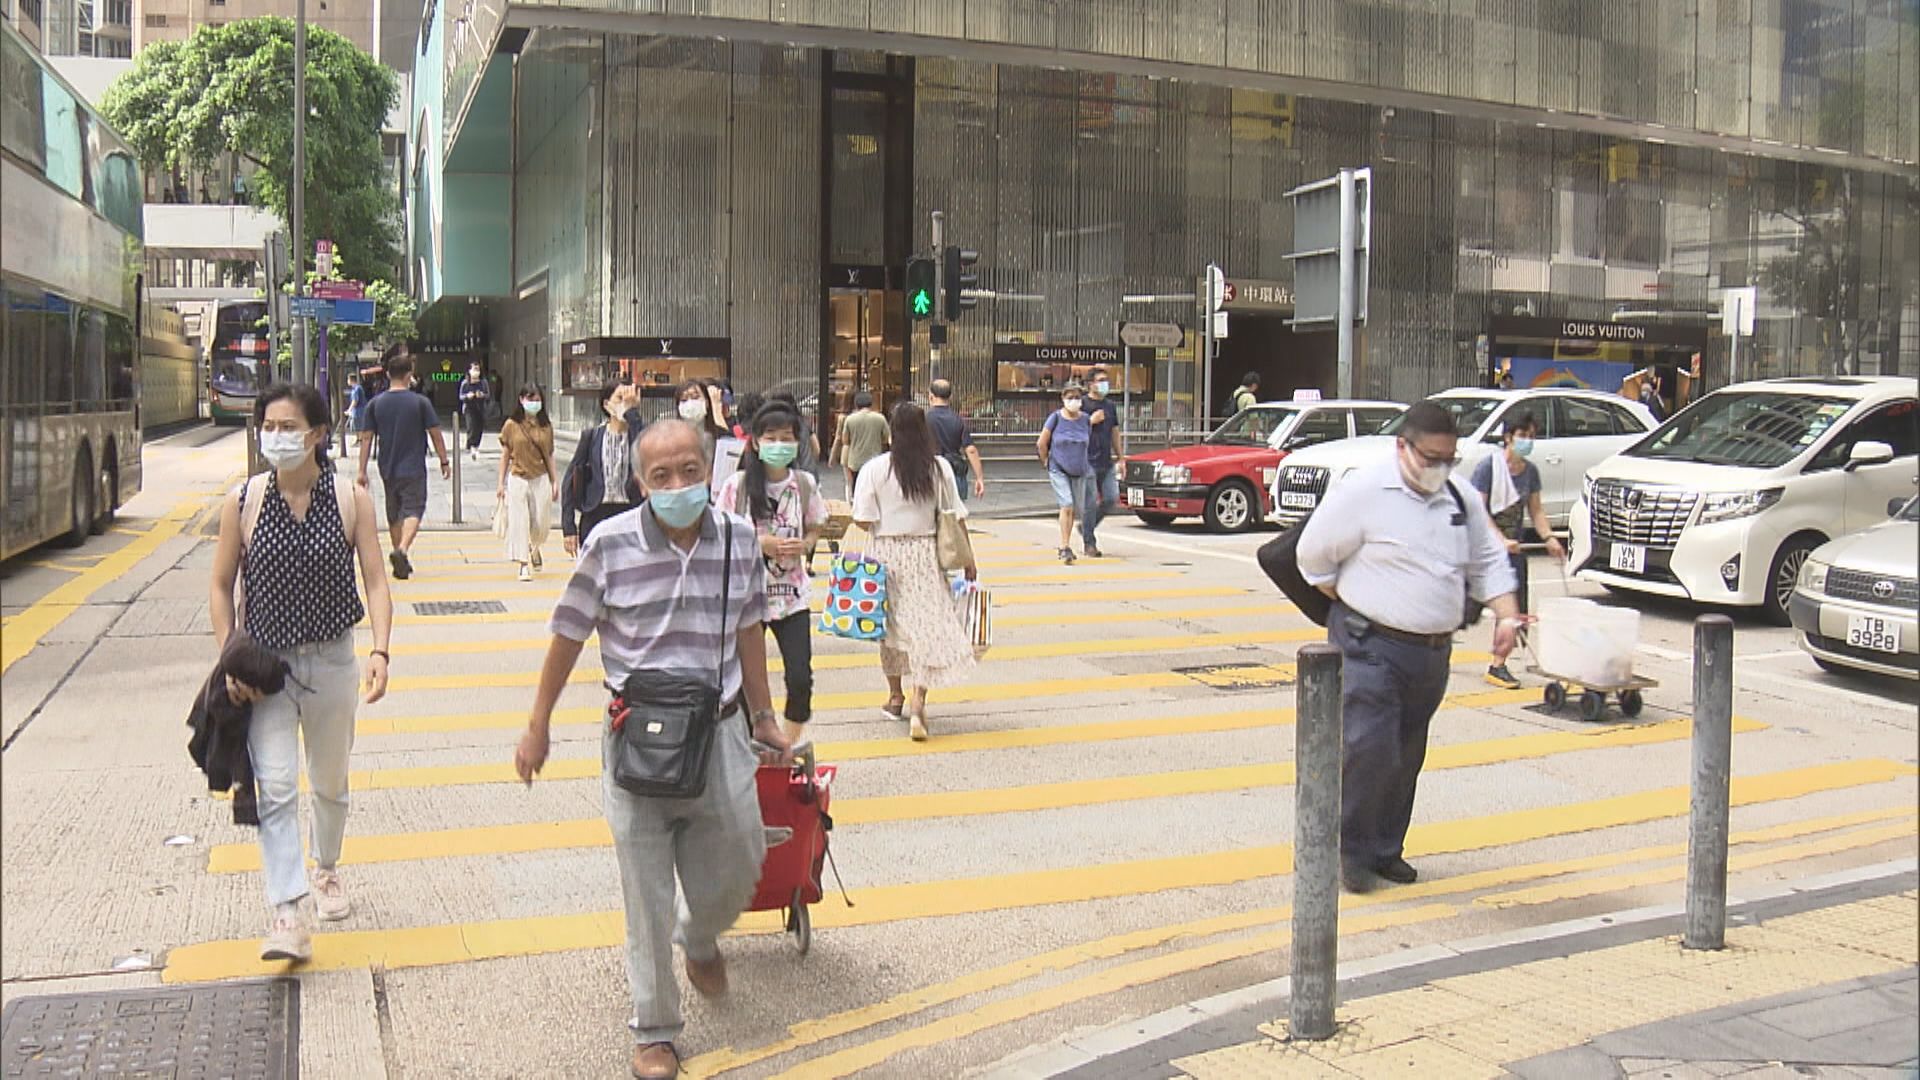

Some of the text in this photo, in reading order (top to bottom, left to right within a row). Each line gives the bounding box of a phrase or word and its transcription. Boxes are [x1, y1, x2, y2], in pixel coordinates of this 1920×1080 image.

[1244, 285, 1288, 304] 中環站
[1562, 322, 1645, 339] LOUIS VUITTON
[1036, 348, 1117, 360] LOUIS VUITTON
[1621, 545, 1636, 558] VN
[1617, 556, 1636, 570] 184
[1864, 616, 1884, 632] TB
[1850, 629, 1895, 649] 3928
